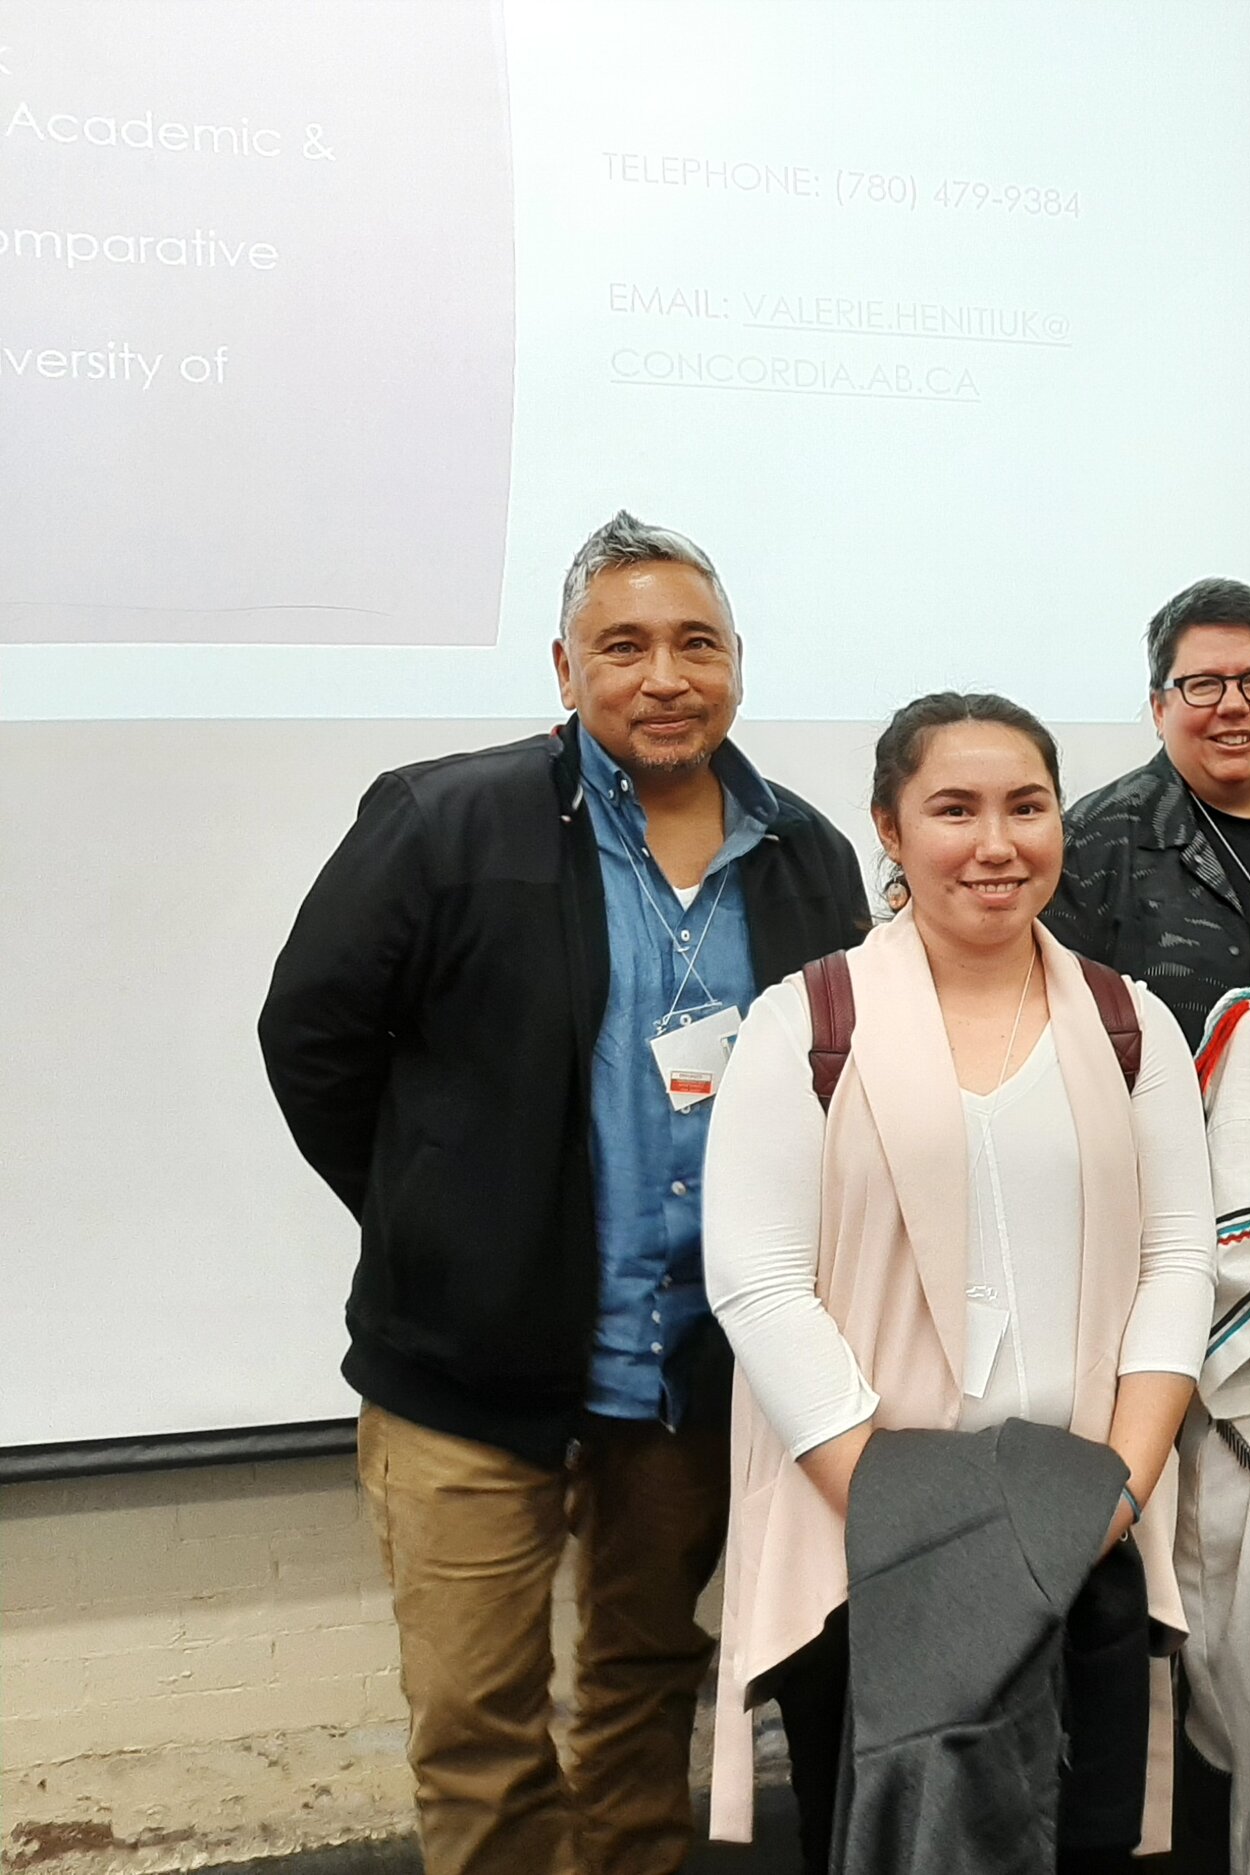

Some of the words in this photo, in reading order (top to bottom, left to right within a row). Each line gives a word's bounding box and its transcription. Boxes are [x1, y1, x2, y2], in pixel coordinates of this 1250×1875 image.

[6, 102, 281, 158] Academic
[302, 122, 336, 161] &
[601, 151, 821, 198] TELEPHONE:
[836, 169, 918, 212] (780)
[933, 179, 1082, 219] 479-9384
[608, 282, 730, 319] EMAIL:
[743, 291, 1072, 344] VALERIE.HENITIUK@
[0, 341, 164, 391] versity
[180, 346, 229, 383] of
[610, 347, 981, 400] CONCORDIA.AB.CA
